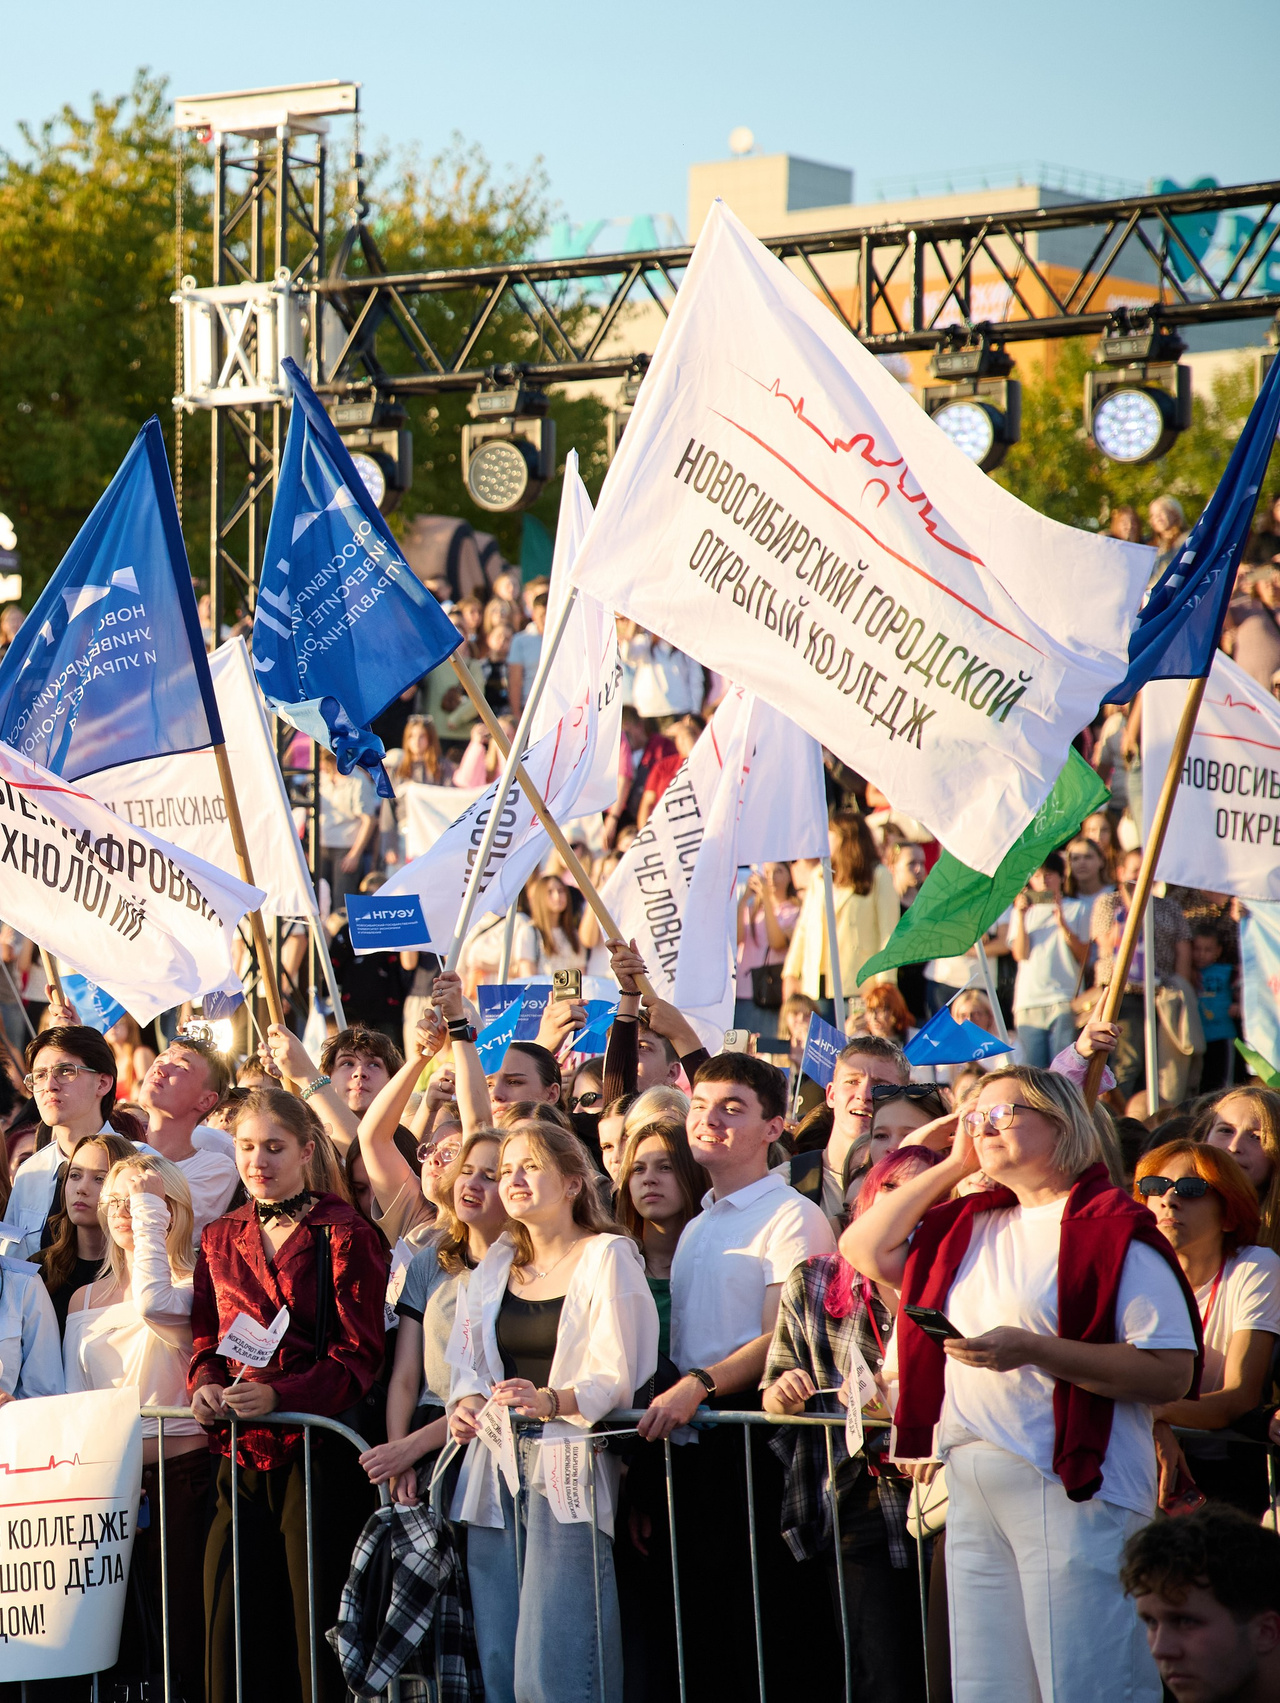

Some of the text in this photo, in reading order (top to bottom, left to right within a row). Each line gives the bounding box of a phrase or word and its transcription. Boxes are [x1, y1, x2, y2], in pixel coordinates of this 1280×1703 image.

[673, 438, 1033, 723] НОВОСИБИРСКИЙ ГОРОДСКОЙ
[689, 528, 938, 750] ОТКРЫТЫЙ КОЛЛЕДЖ
[372, 908, 415, 920] НГУЭУ
[503, 999, 547, 1010] НУЭУ
[8, 1510, 129, 1551] КОЛЛЕДЖЕ
[65, 1553, 125, 1595] ДЕЛА
